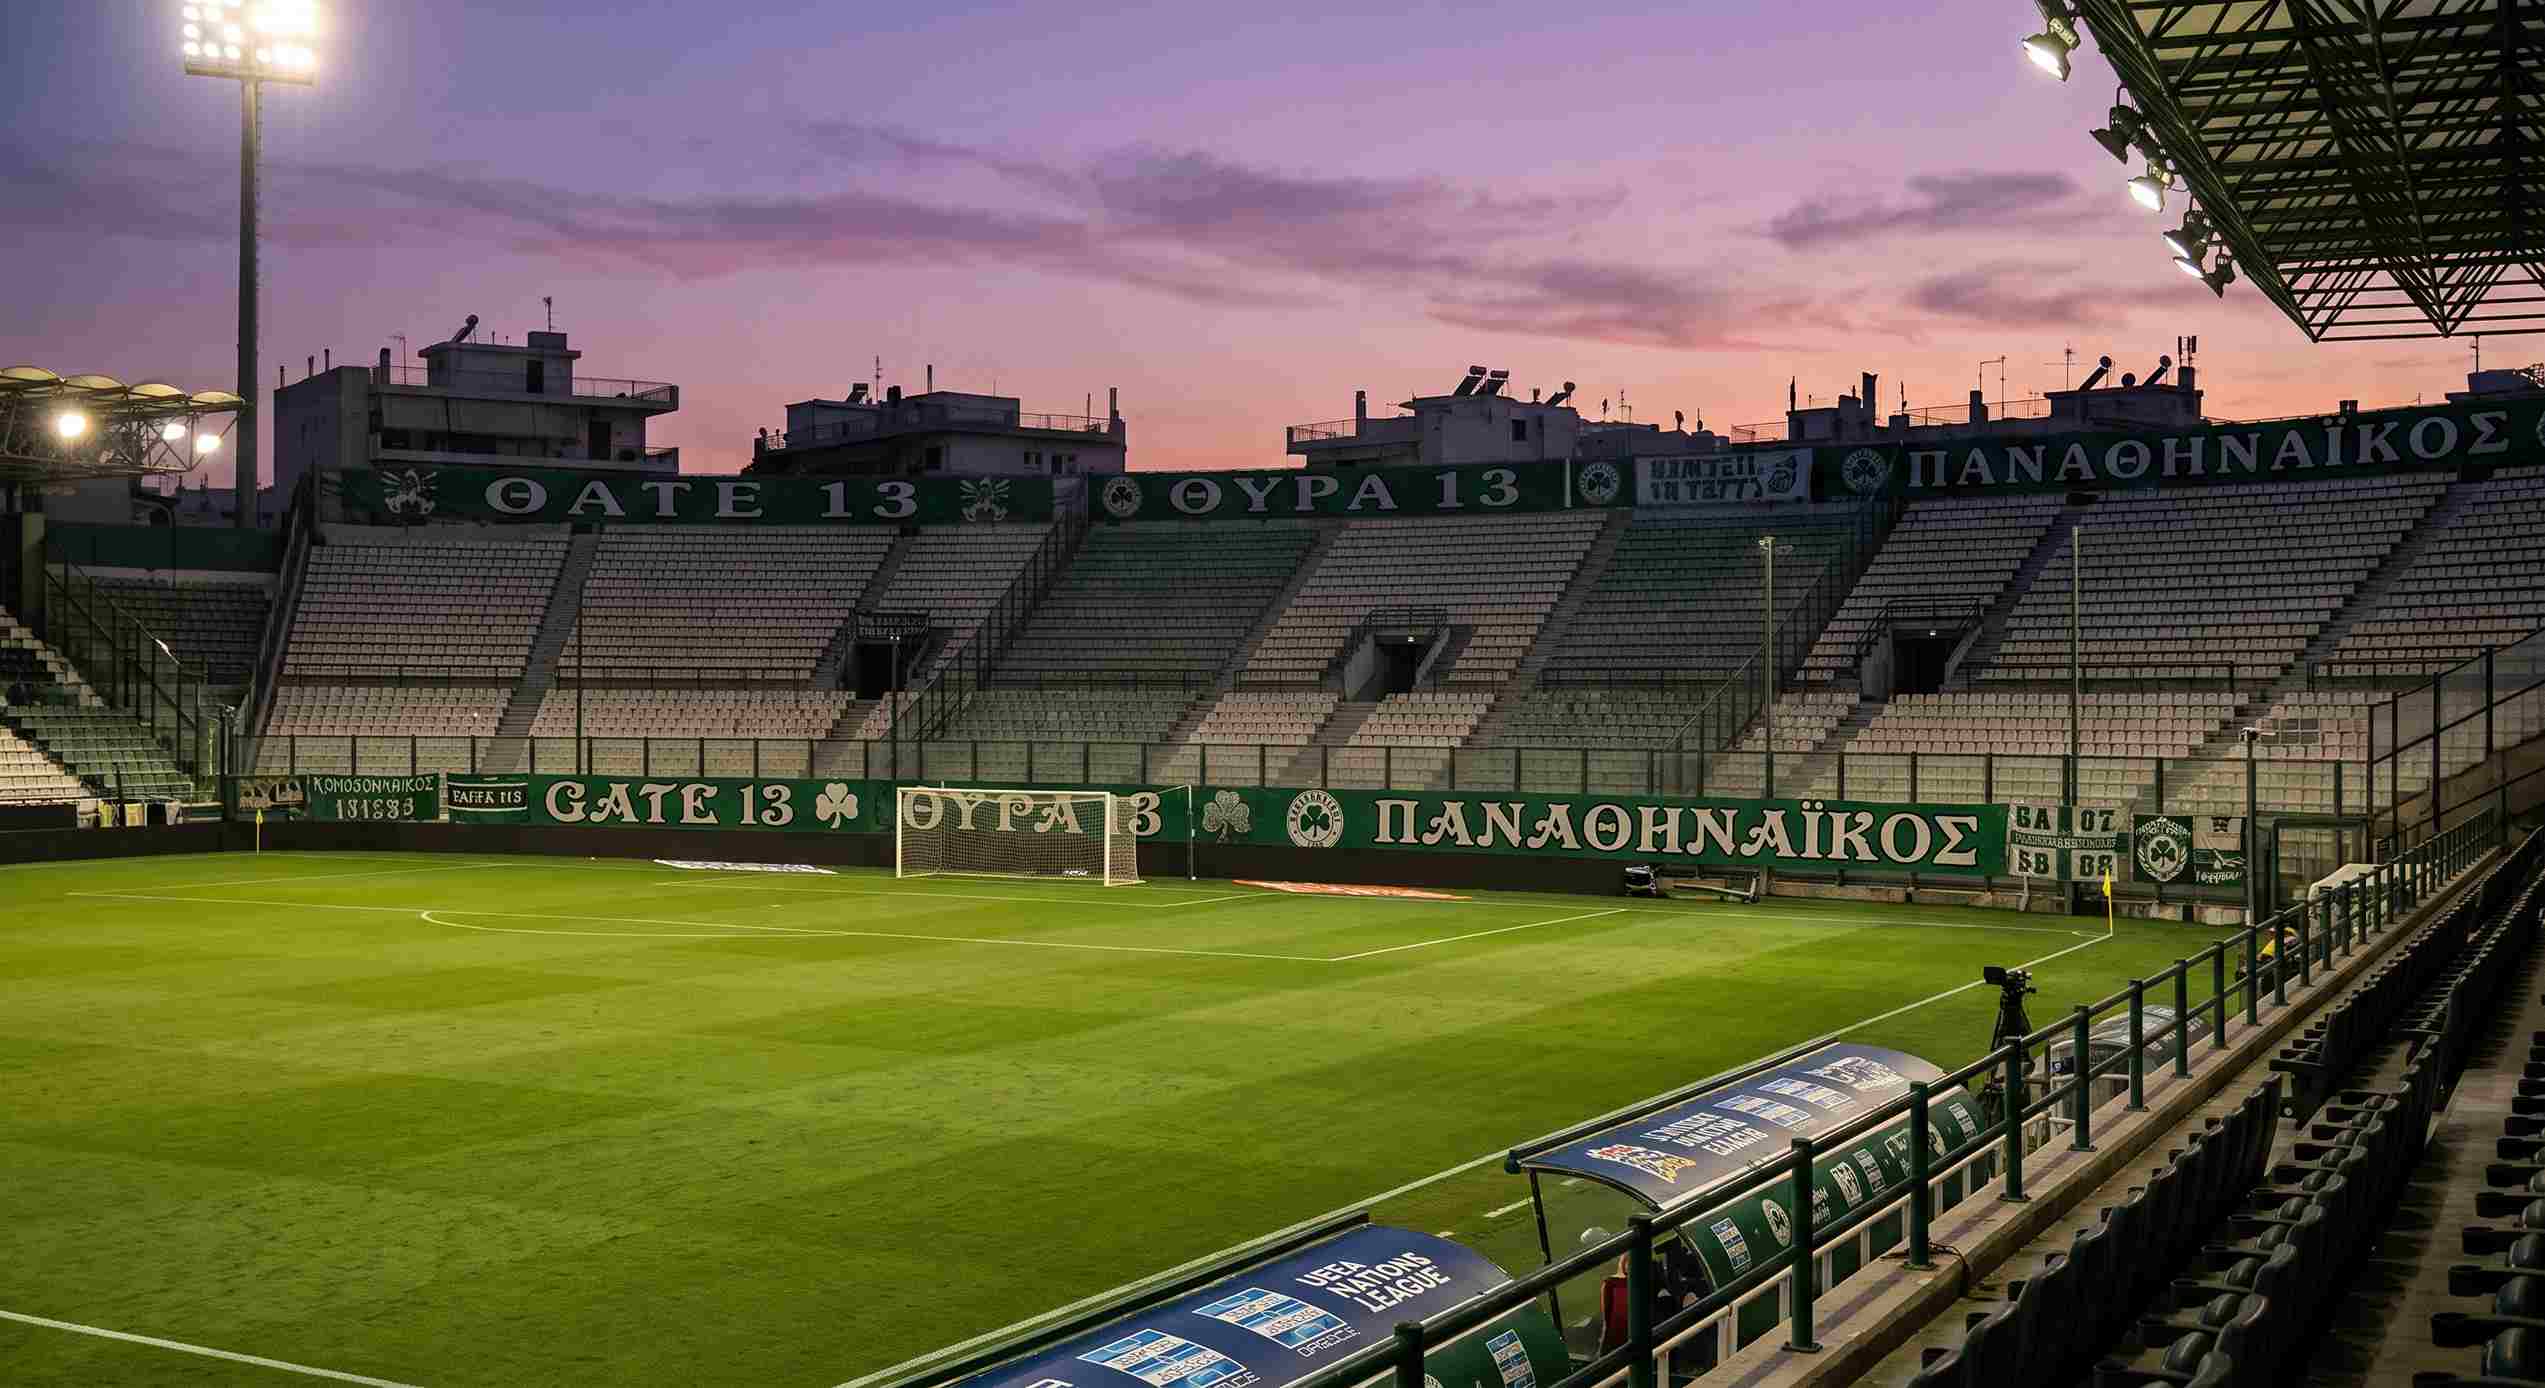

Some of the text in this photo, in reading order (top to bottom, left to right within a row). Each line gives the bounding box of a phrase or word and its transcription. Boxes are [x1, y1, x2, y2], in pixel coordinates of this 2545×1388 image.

[1907, 410, 2510, 488] ΠΑΝΑΘΗΝΑΪΚΟΣ
[818, 481, 919, 517] 13
[1170, 473, 1398, 514] ΘΥΡΑ
[1435, 468, 1519, 508] 13
[544, 781, 794, 824] GATE 13
[1374, 798, 1979, 866] ΠΑΝΑΘΗΝΑΪΚΟΣ
[1353, 1267, 1451, 1313] LEAGUE
